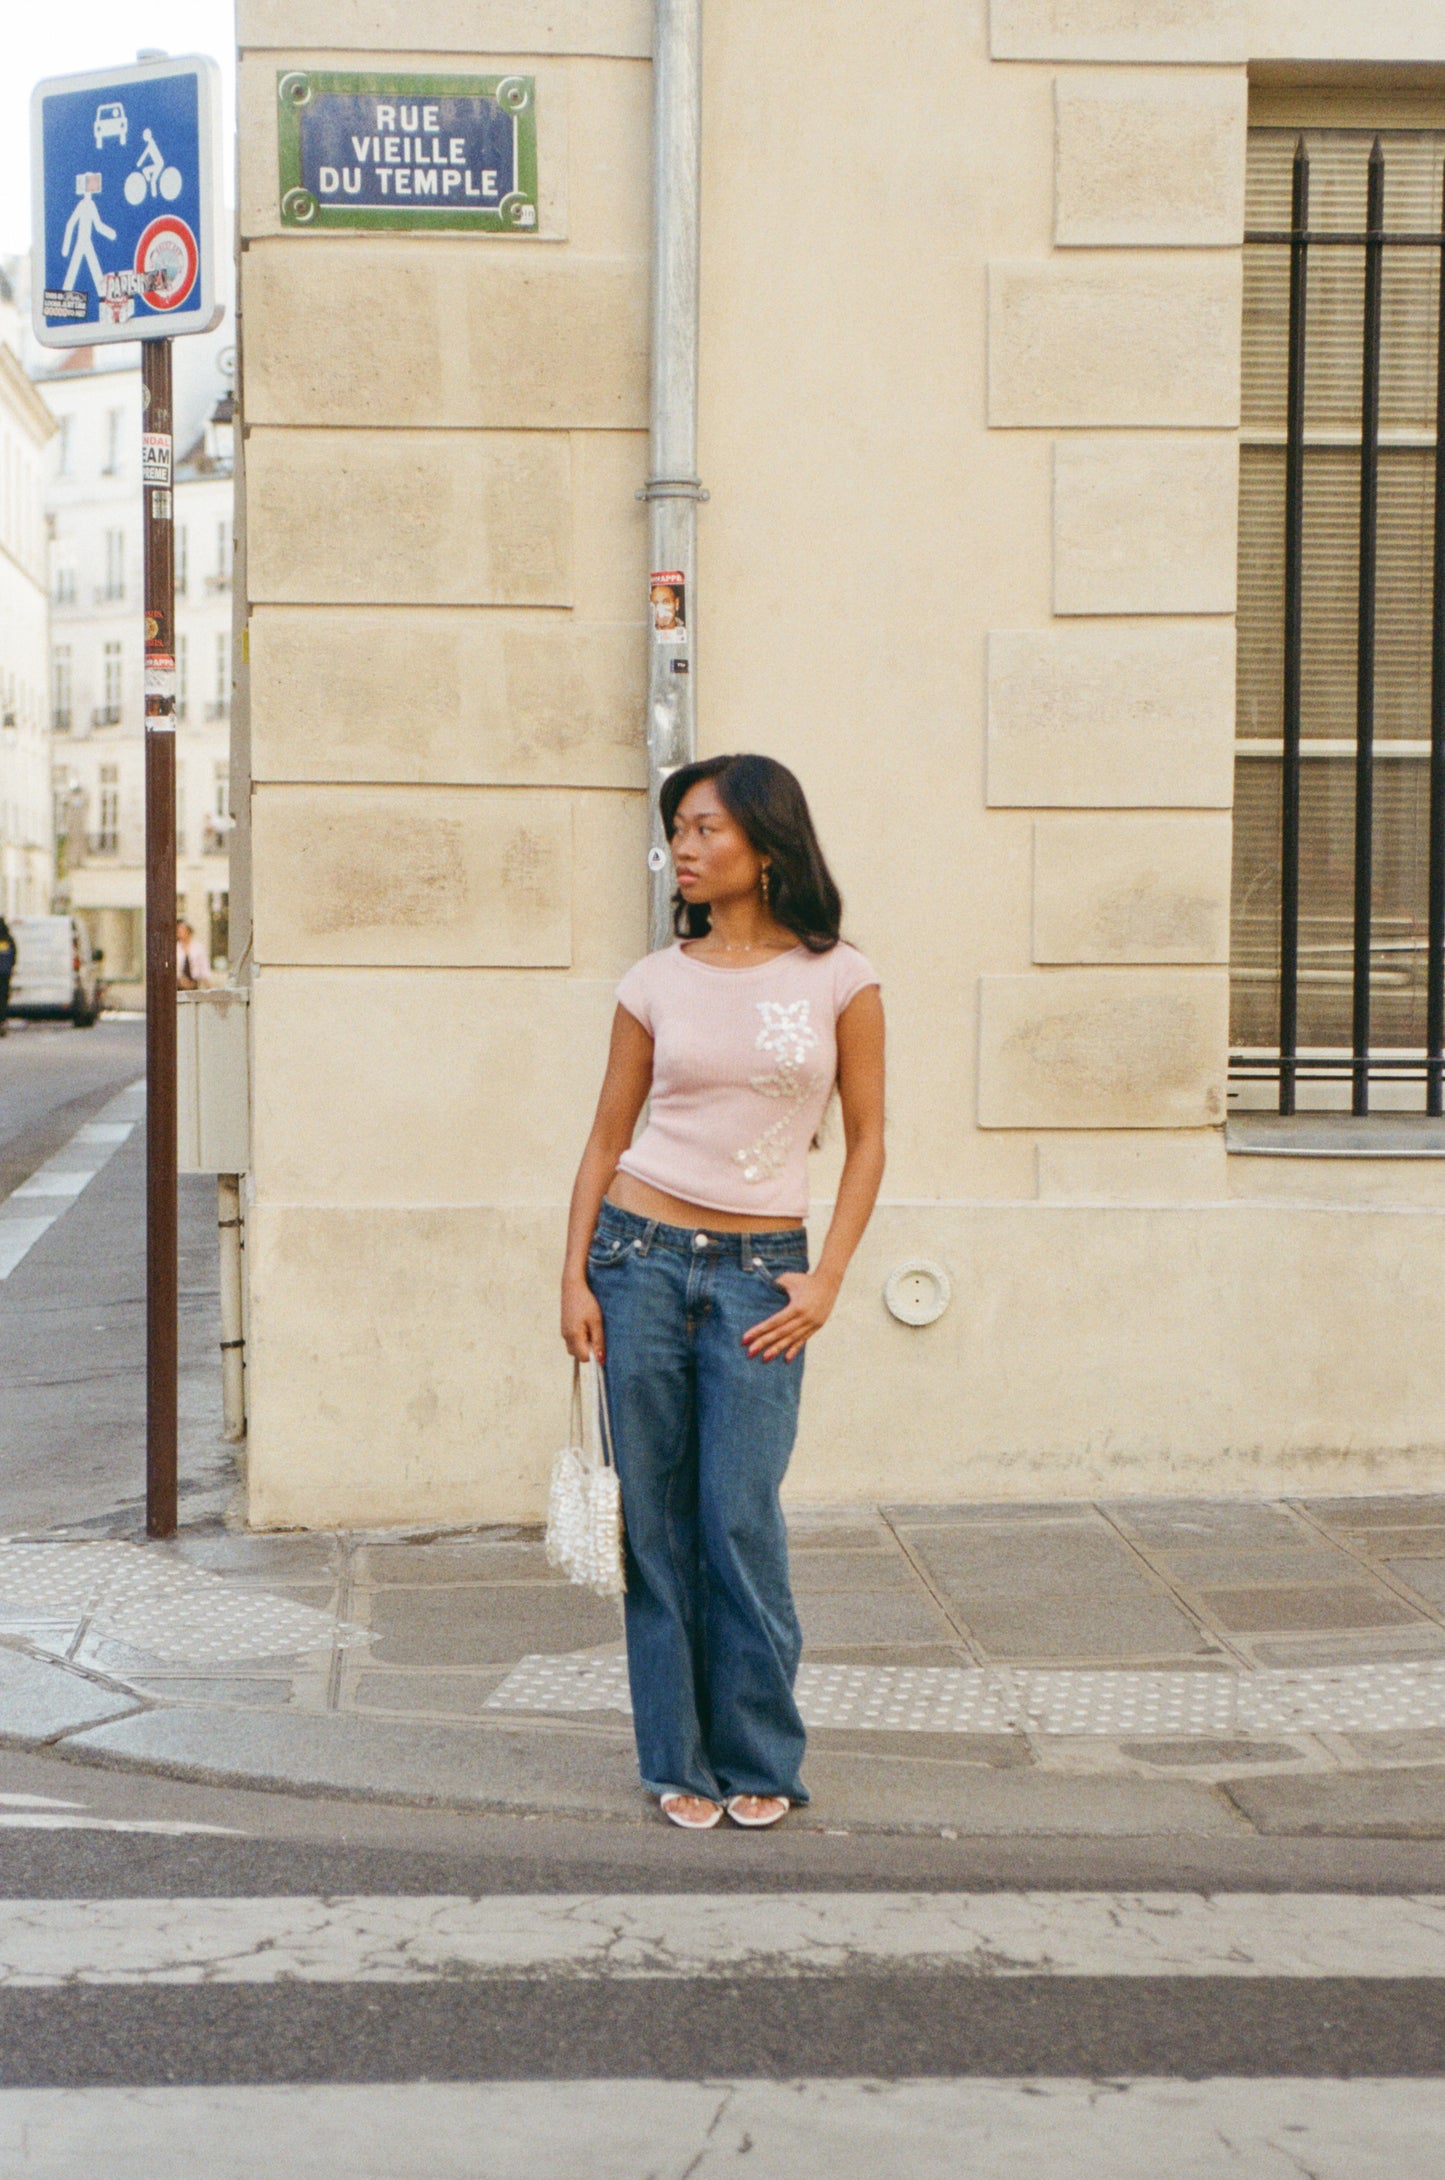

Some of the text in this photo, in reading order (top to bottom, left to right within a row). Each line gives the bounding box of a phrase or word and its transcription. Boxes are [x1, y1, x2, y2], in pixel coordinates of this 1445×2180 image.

[376, 105, 440, 132] RUE
[352, 136, 467, 164] VIEILLE
[319, 167, 499, 196] DU TEMPLE
